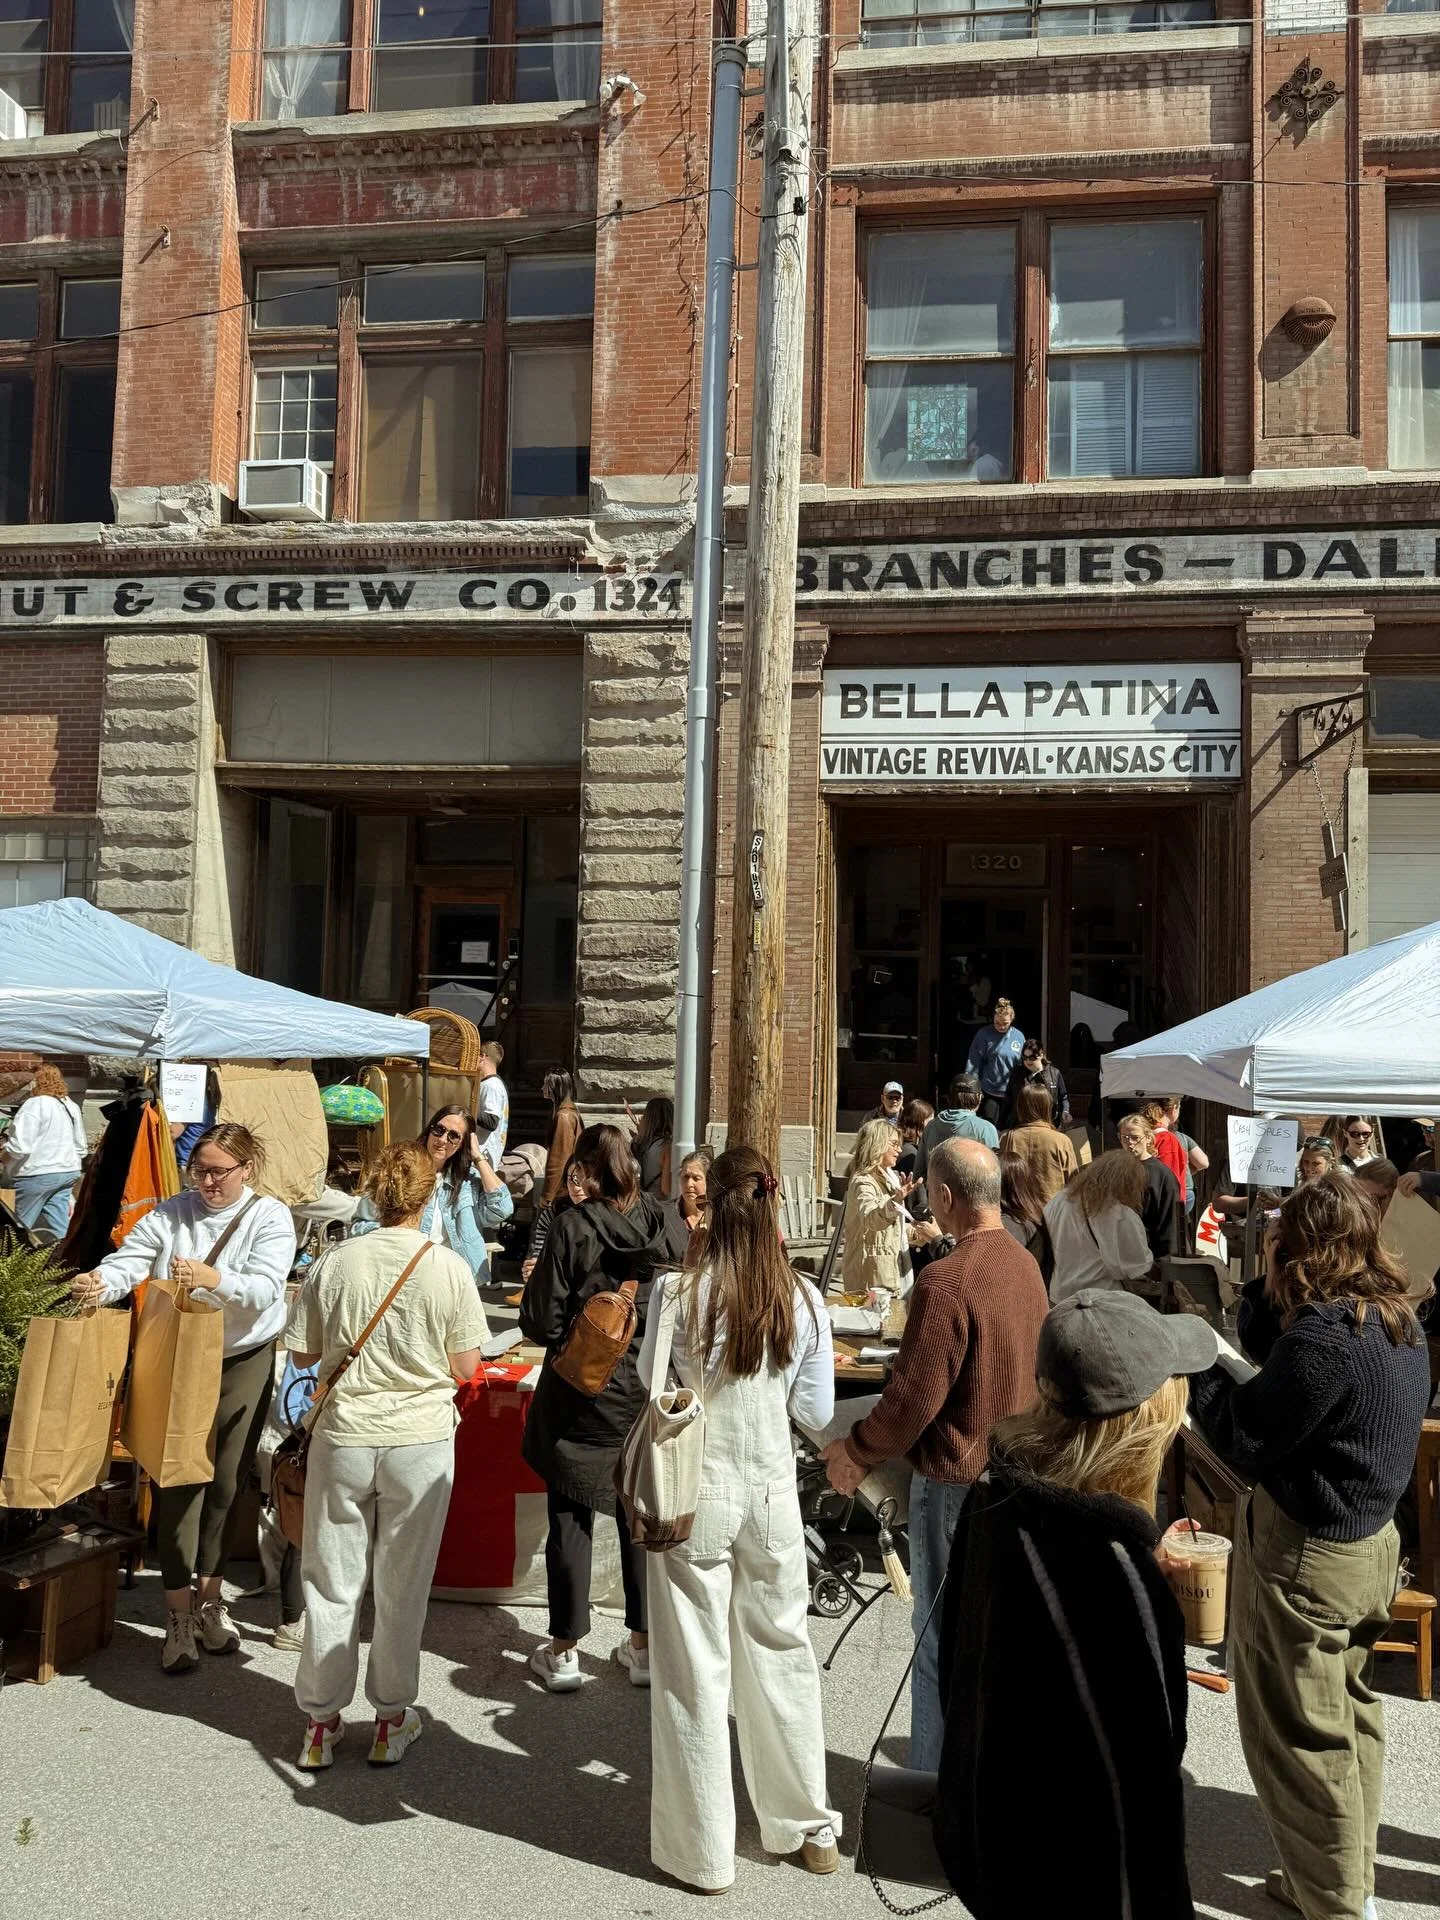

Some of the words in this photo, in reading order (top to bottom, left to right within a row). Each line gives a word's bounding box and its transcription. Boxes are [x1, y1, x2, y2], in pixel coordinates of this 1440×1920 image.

[796, 543, 1164, 594] BRANCHES
[1262, 538, 1440, 582] DAL
[0, 586, 89, 617] UT
[112, 582, 154, 617] &
[181, 580, 417, 614] SCREW
[458, 578, 576, 612] CO.
[592, 577, 683, 612] 1324
[840, 682, 1010, 719] BELLA
[1024, 678, 1220, 717] PATINA
[823, 747, 928, 775] VINTAGE
[1173, 744, 1238, 773] CITY
[970, 855, 1022, 870] 1320
[1233, 1119, 1251, 1137] CASH
[1255, 1121, 1291, 1139] SALES
